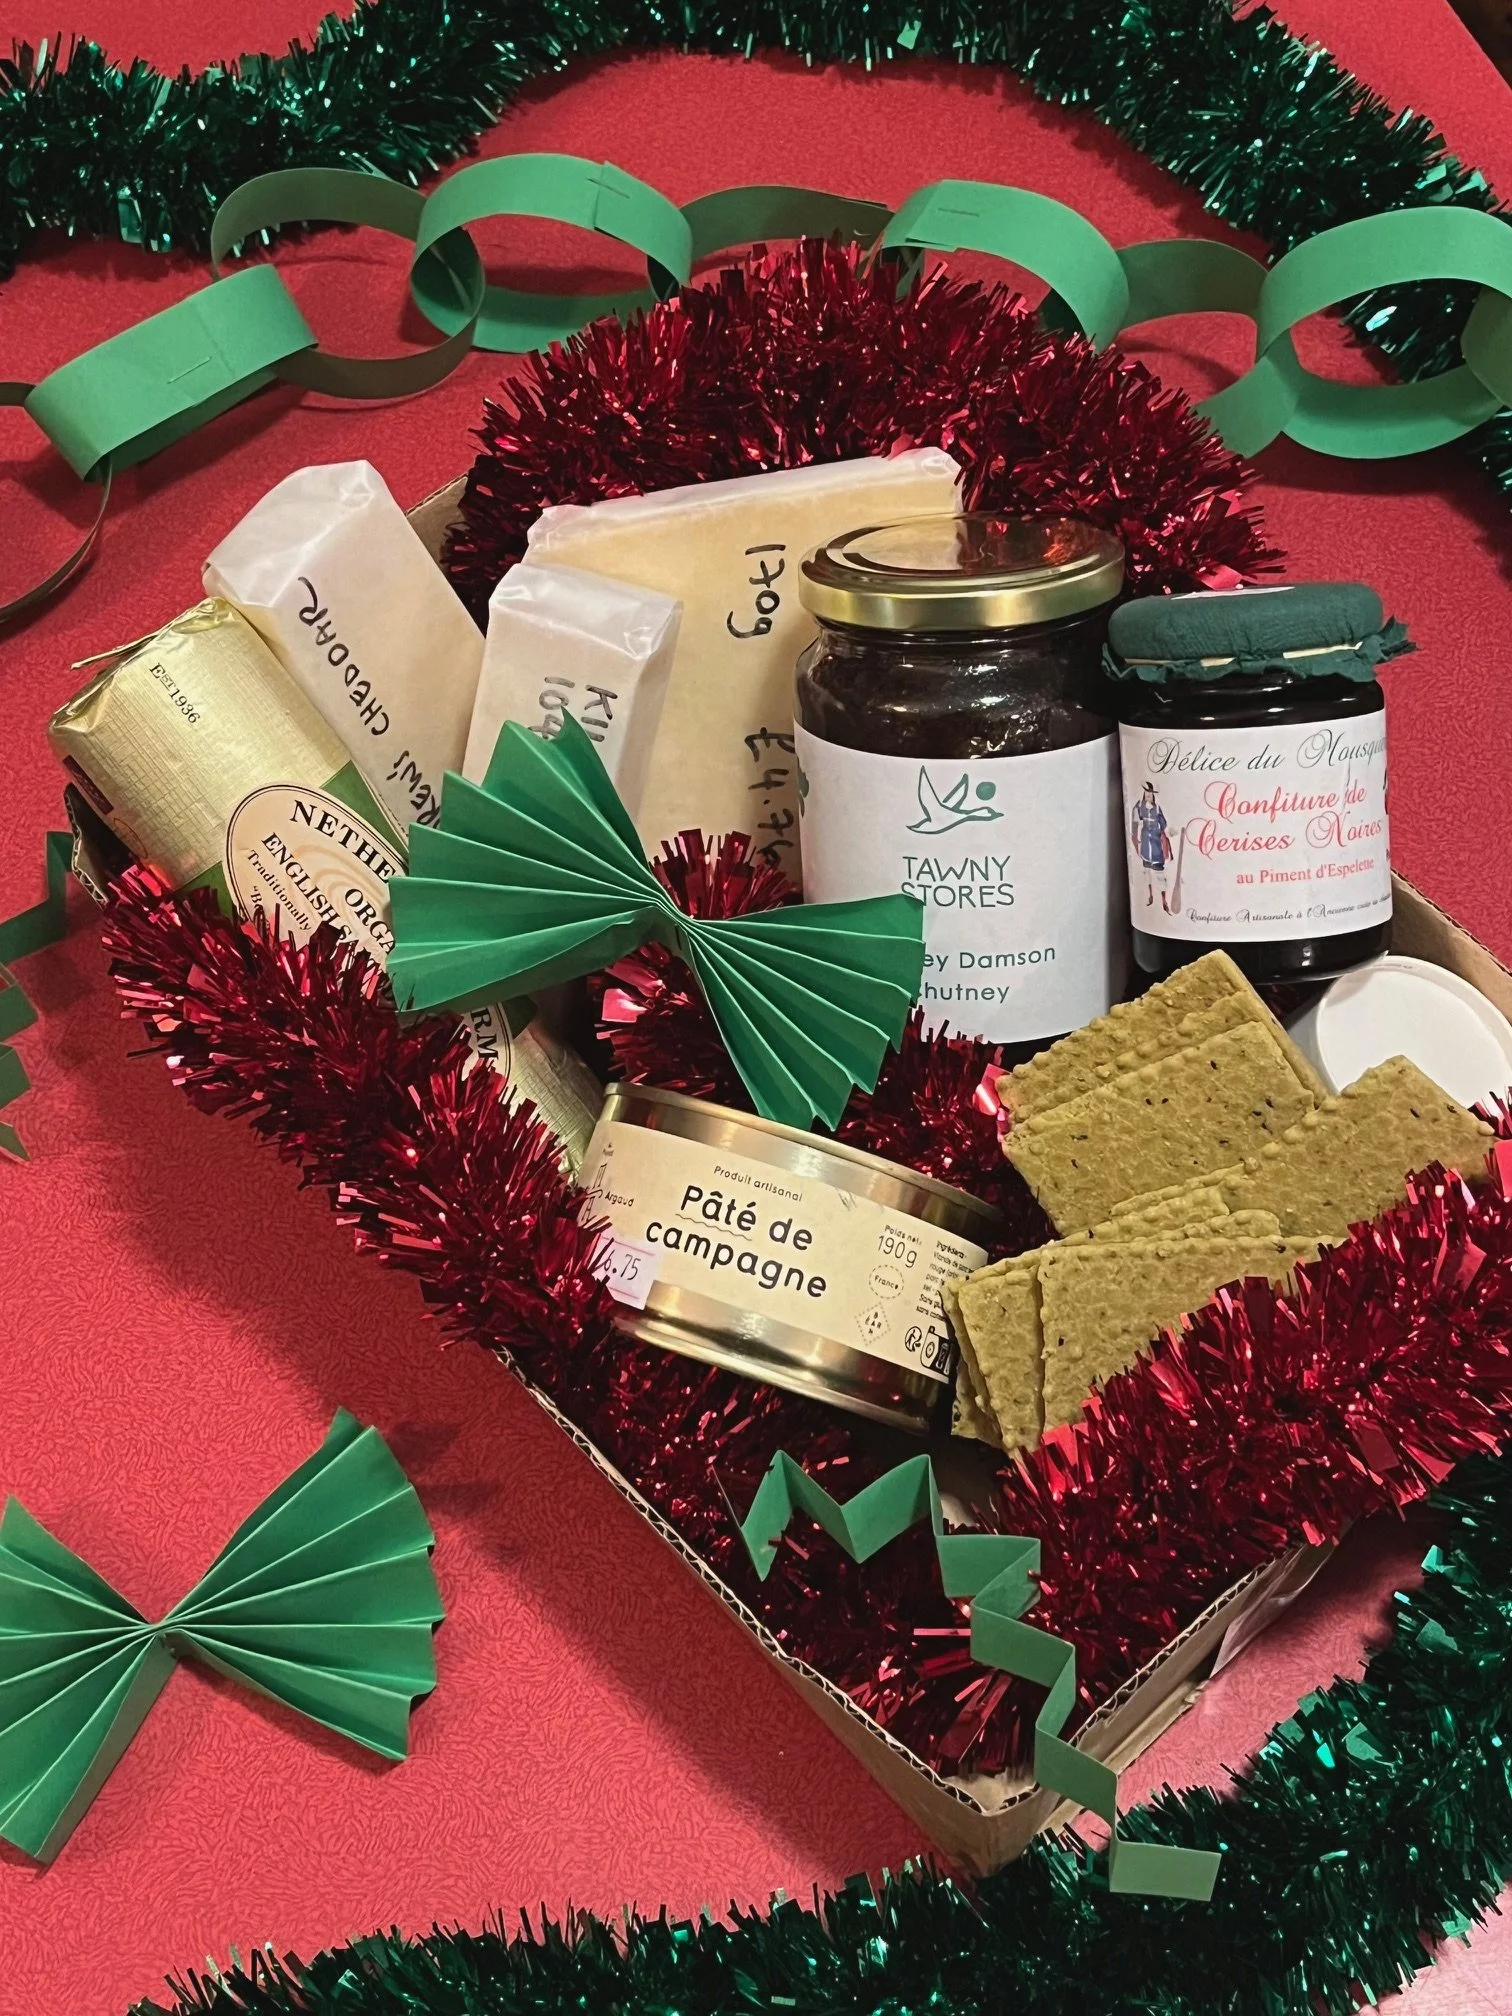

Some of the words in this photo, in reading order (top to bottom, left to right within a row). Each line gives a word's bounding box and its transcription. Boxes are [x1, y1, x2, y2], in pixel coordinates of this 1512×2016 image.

[727, 544, 786, 638] 170g
[1147, 737, 1241, 774] Délice
[1247, 744, 1285, 771] du
[386, 750, 440, 829] REW'S
[1204, 781, 1339, 824] Confiture
[1345, 779, 1367, 805] de
[1186, 818, 1295, 860] Cerises
[1305, 811, 1382, 848] Noires
[261, 832, 340, 923] ENGLISH
[902, 856, 1011, 881] TAWNY
[1236, 872, 1254, 884] au
[1260, 868, 1312, 884] Piment
[1316, 858, 1374, 879] d'Espelette
[247, 849, 312, 931] Traditionally
[901, 882, 1015, 908] STORES
[960, 947, 1055, 969] Damson
[920, 982, 1010, 1003] hutney
[604, 1191, 635, 1207] Argaud
[713, 1165, 751, 1185] Produit
[753, 1180, 803, 1202] artisanal
[680, 1184, 757, 1231] Pâté
[769, 1218, 812, 1250] de
[884, 1225, 906, 1239] Poids
[646, 1221, 827, 1297] campagne
[874, 1275, 899, 1290] France
